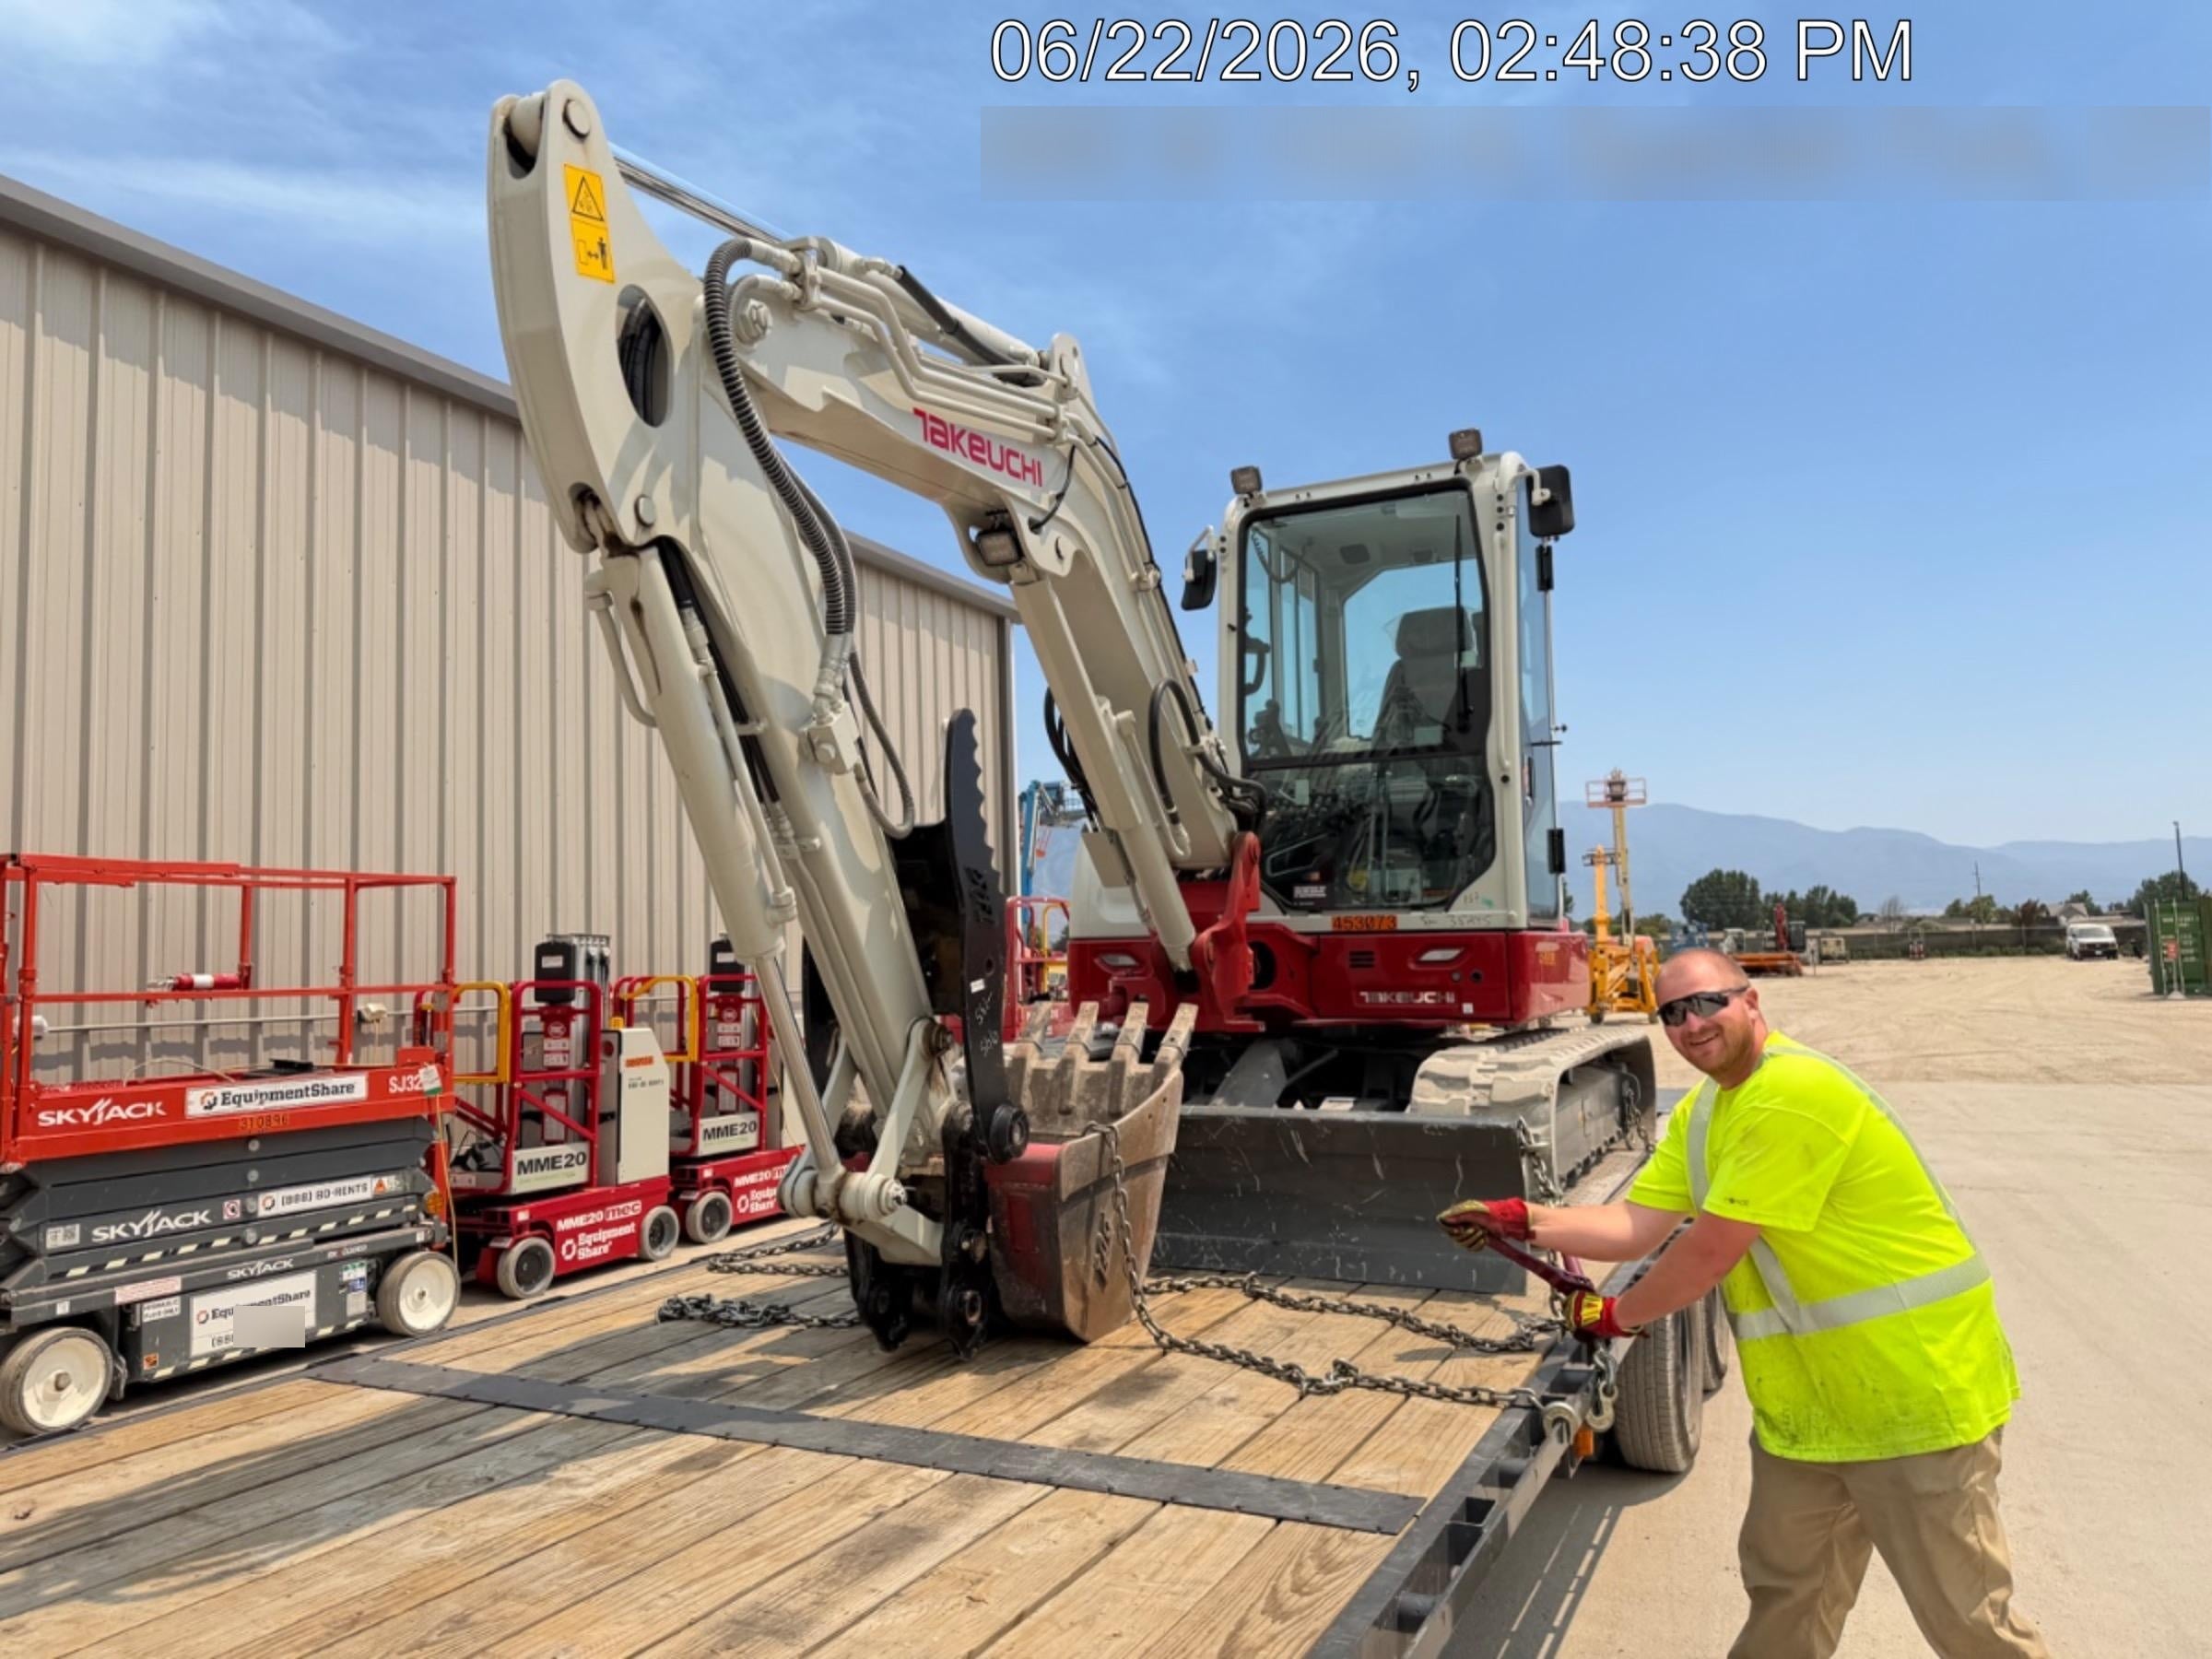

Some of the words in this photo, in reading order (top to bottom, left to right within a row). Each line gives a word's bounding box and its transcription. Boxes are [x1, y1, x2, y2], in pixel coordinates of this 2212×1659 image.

[220, 1082, 356, 1108] EquipmentShare
[388, 1074, 424, 1094] SJ32
[38, 1098, 167, 1127] SKYJACK
[702, 1120, 758, 1141] MME20
[517, 1151, 587, 1176] MME20
[734, 1170, 771, 1188] MME20
[91, 1208, 212, 1242] SKYJACK
[557, 1209, 604, 1232] MME20
[578, 1222, 635, 1246] Equipment
[577, 1242, 611, 1261] Share
[227, 1258, 295, 1280] SKYJACK
[211, 1289, 311, 1321] EquentShare
